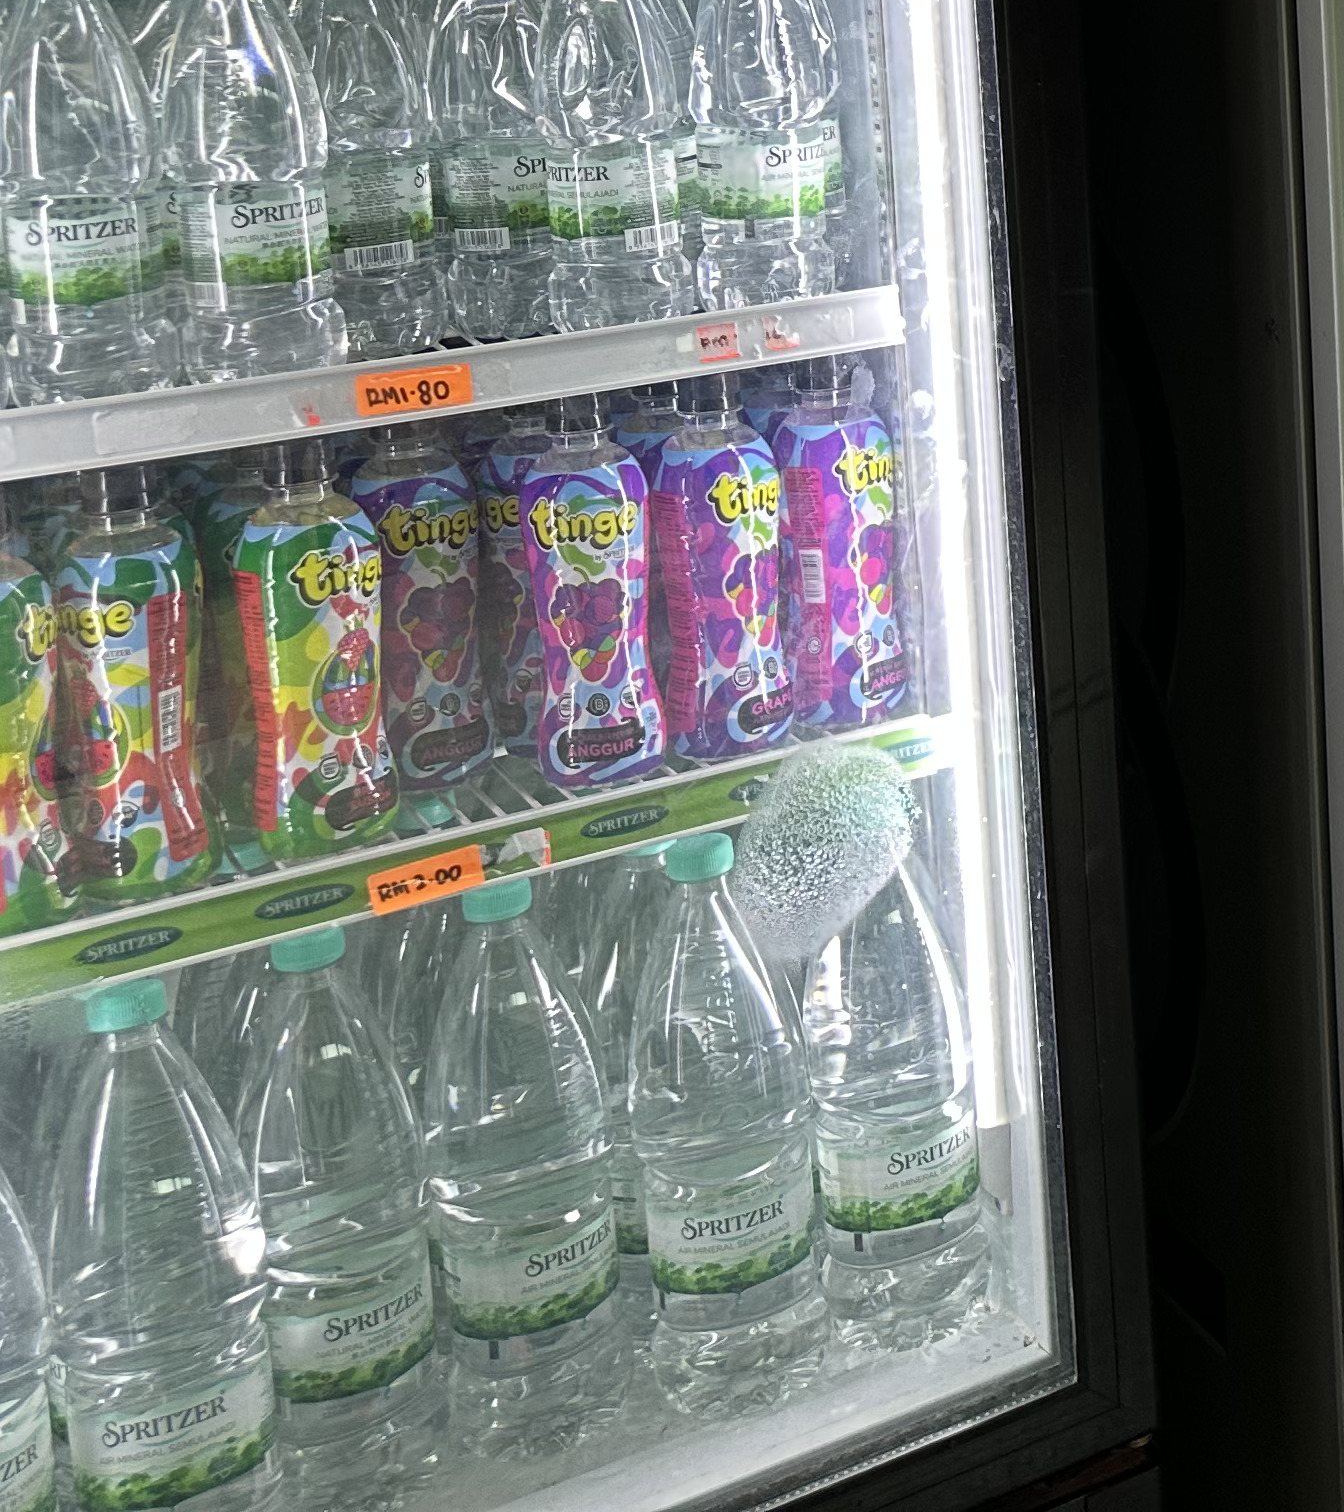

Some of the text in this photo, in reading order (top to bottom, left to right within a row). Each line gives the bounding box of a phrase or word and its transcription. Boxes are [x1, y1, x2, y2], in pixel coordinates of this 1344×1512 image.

[548, 164, 611, 184] PRITZER
[764, 145, 826, 169] SPRITZ
[533, 500, 636, 548] tinge
[567, 736, 635, 760] ANGGUR
[588, 806, 661, 834] SPRITZER
[886, 1124, 972, 1177] SPRITZER
[679, 1195, 784, 1241] SPRITZER
[322, 1283, 425, 1344] SPRITZER
[101, 1393, 228, 1448] SPRITZER
